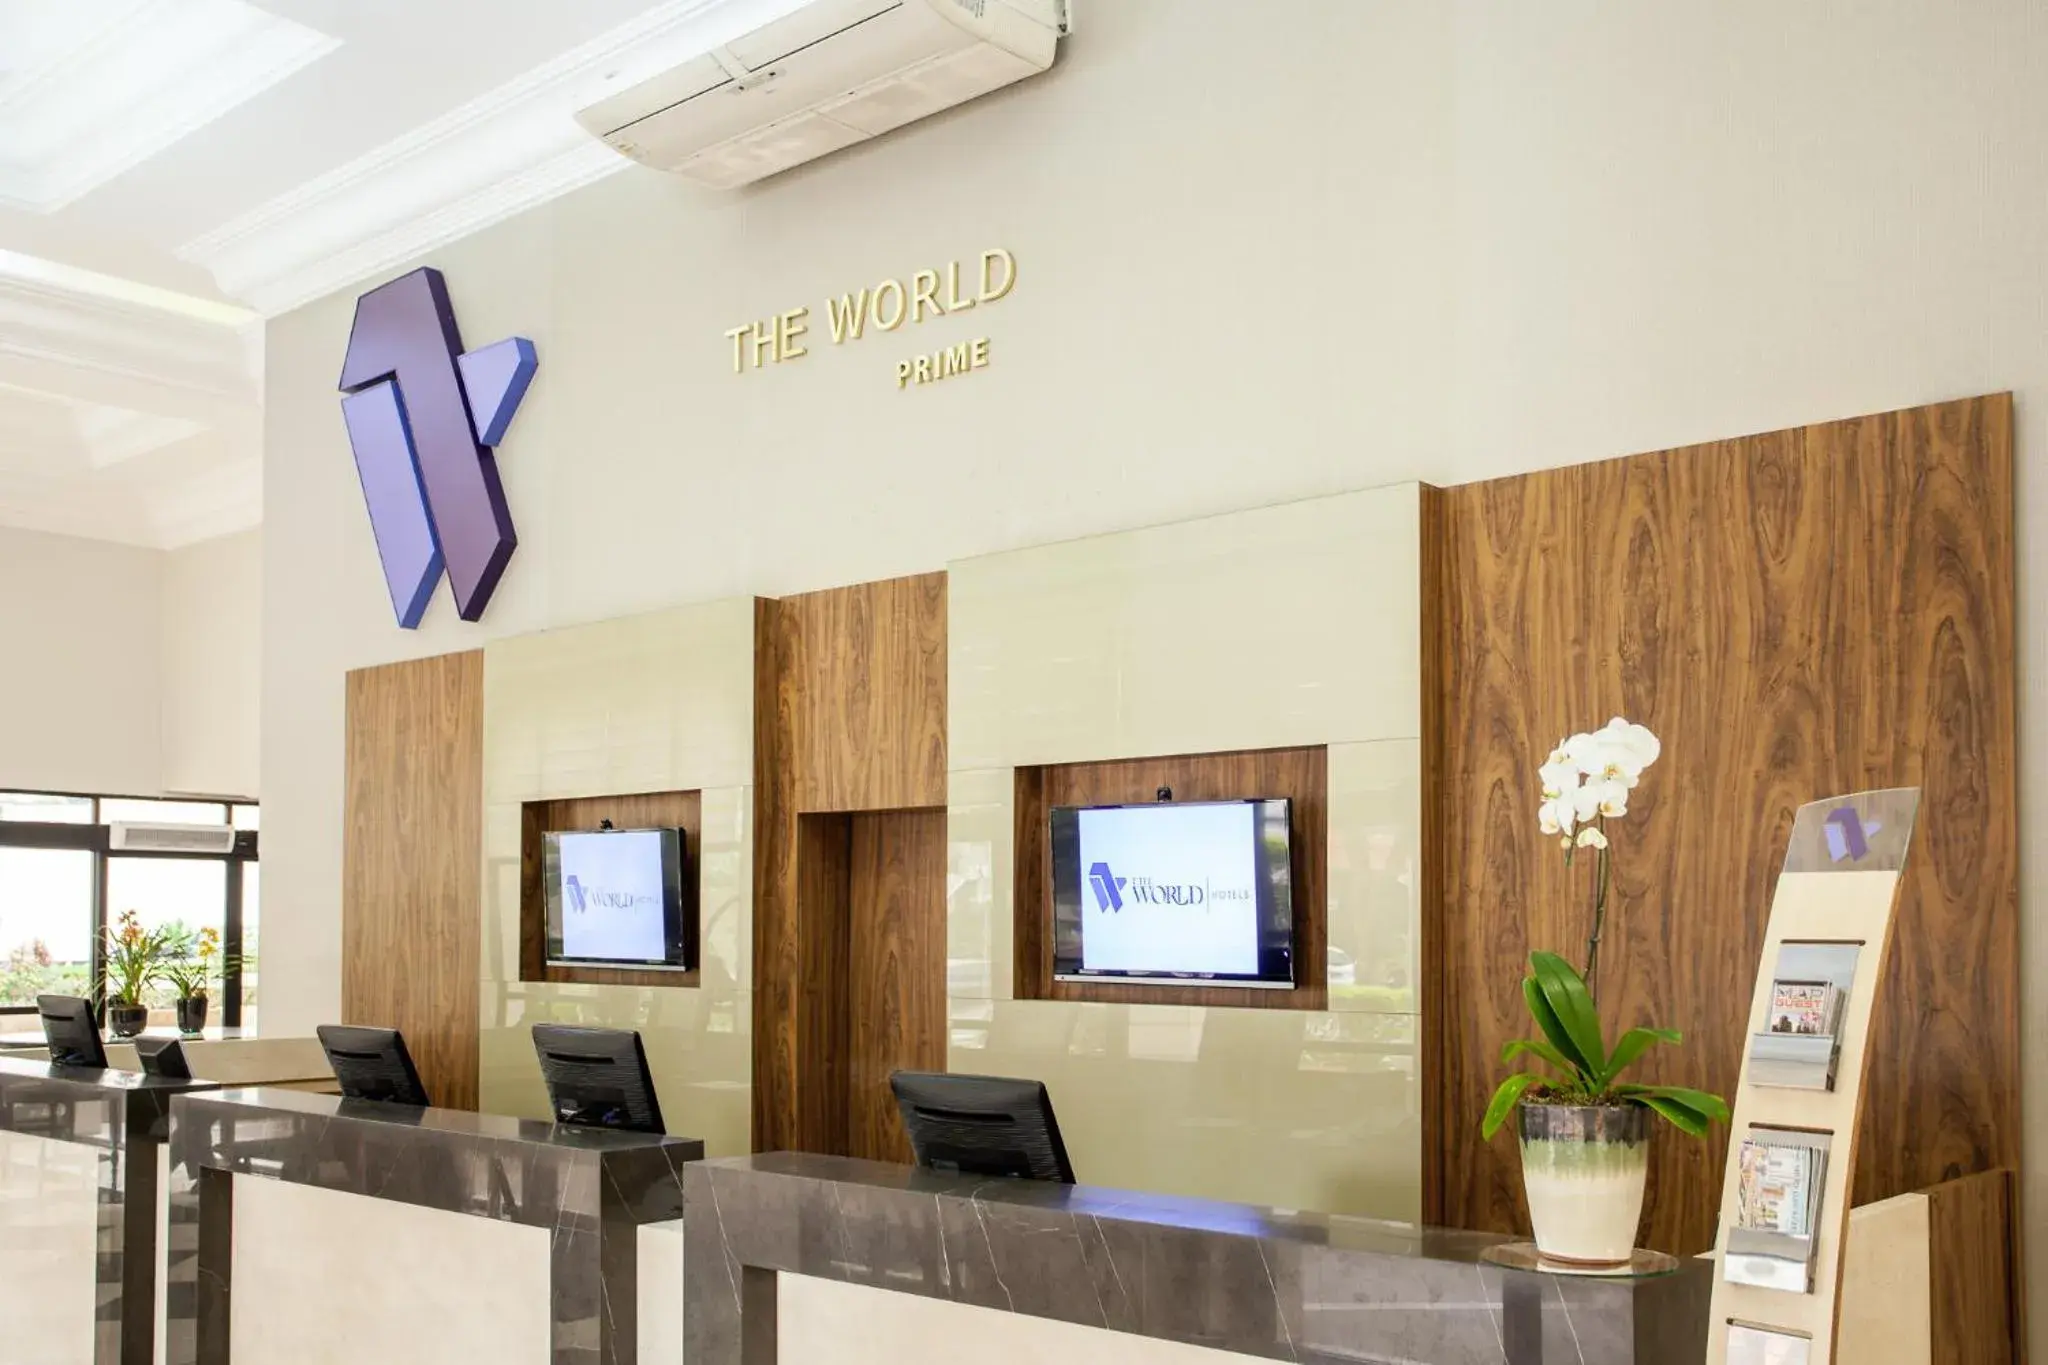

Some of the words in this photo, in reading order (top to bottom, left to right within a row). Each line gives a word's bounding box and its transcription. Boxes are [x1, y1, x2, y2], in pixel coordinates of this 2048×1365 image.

[724, 305, 808, 373] THE
[826, 248, 1017, 344] WORLD
[896, 337, 990, 388] PRIME
[592, 891, 634, 909] WORLD
[1132, 885, 1204, 906] WORLD
